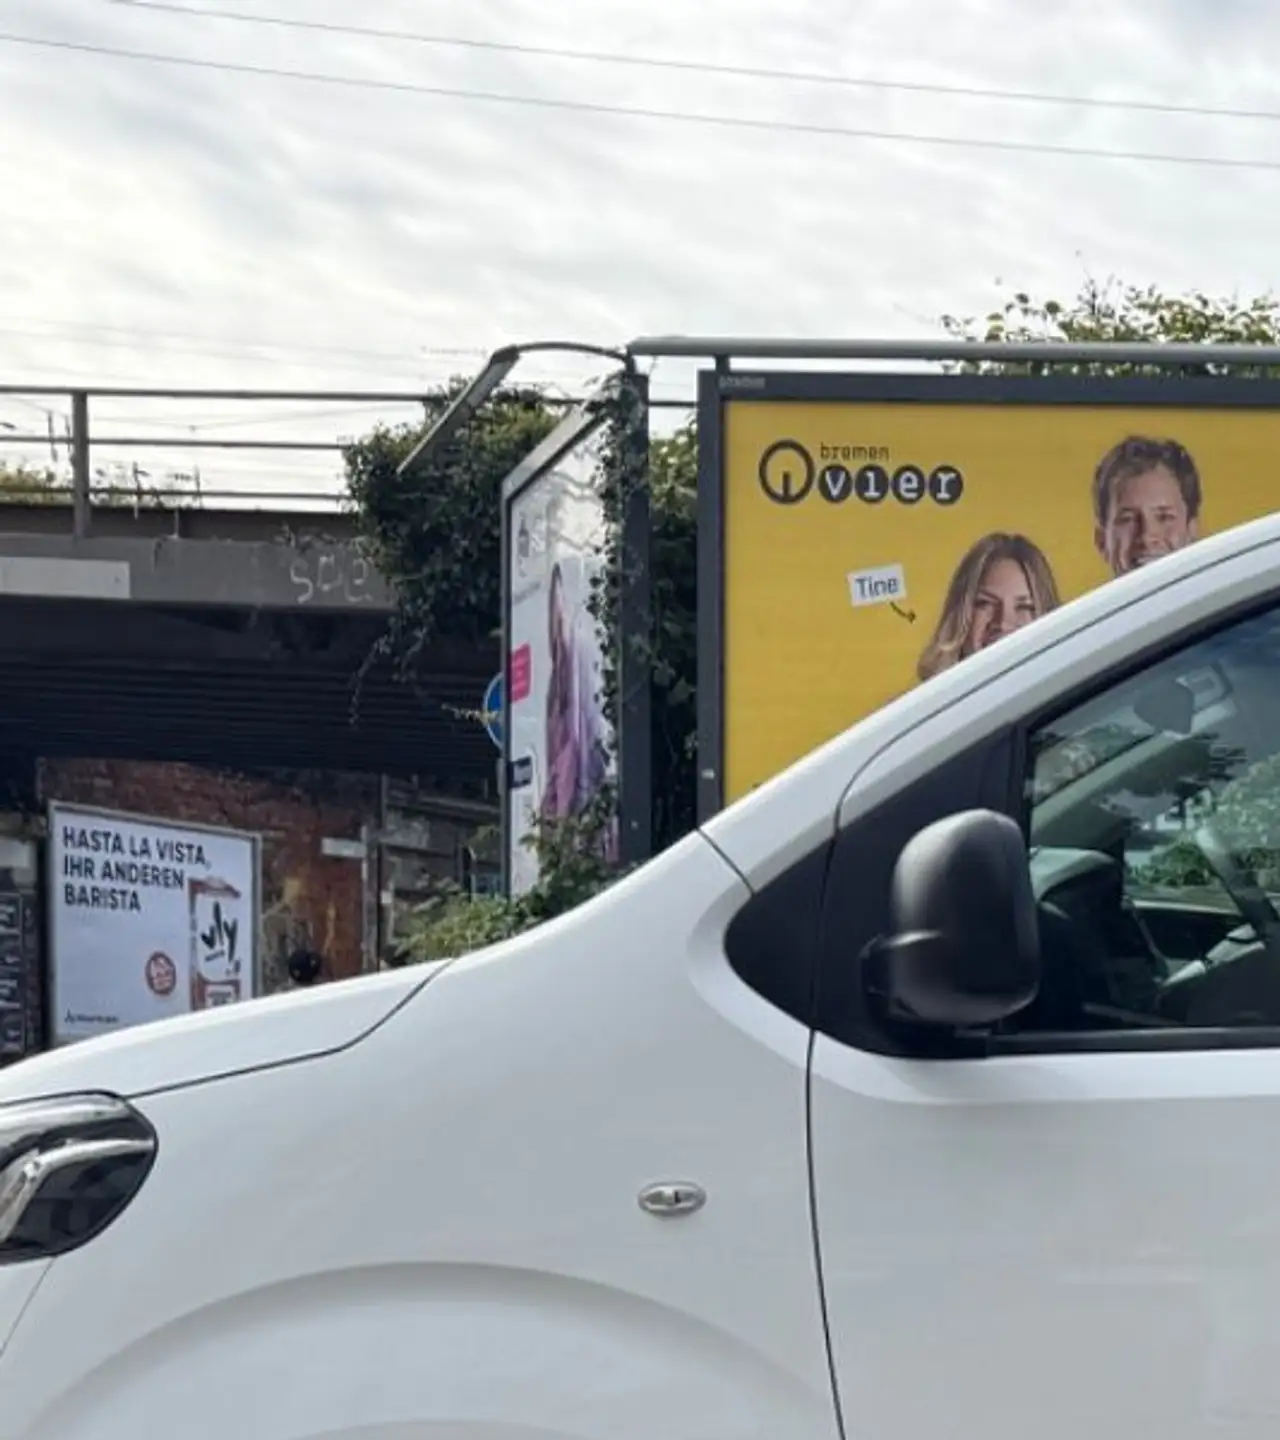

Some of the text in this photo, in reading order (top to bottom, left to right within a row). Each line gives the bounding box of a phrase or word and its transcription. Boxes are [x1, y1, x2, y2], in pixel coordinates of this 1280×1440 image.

[819, 442, 890, 461] bremen
[855, 575, 899, 599] Tine
[62, 825, 125, 855] HASTA
[129, 834, 151, 860] LA
[63, 854, 184, 890] IHR ANDEREN
[64, 882, 142, 913] BARISTA
[200, 901, 238, 963] vly
